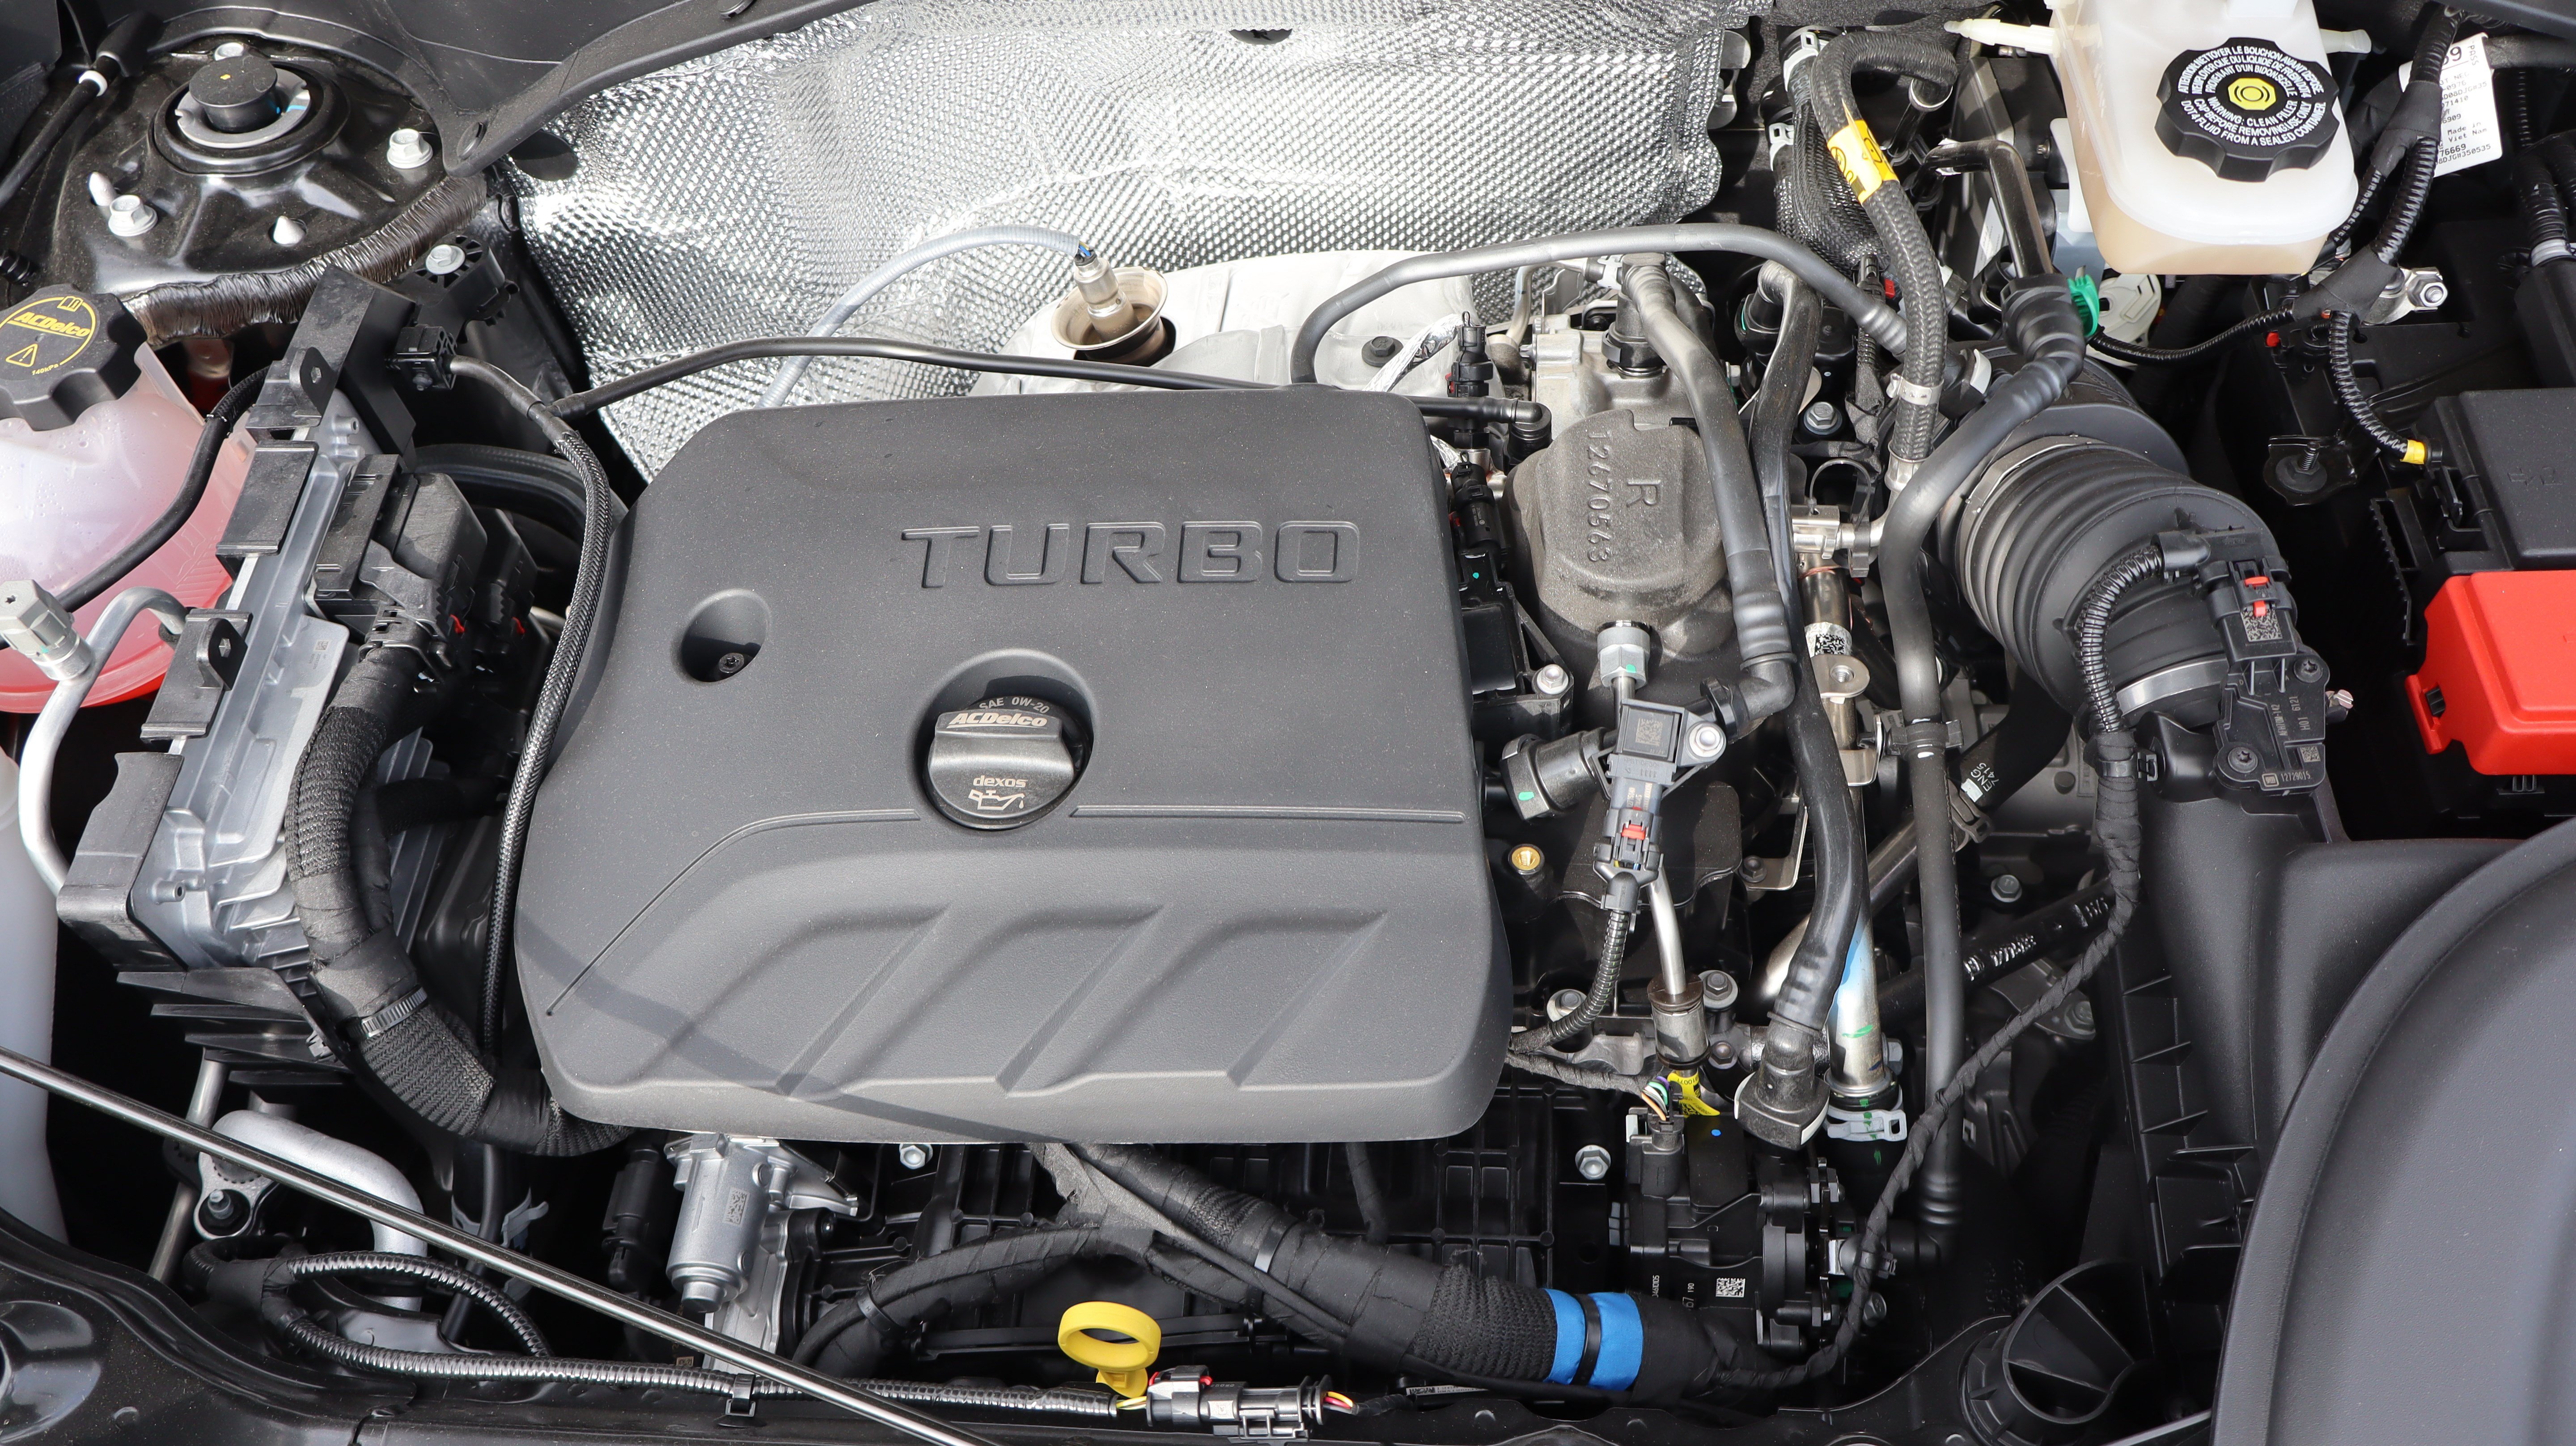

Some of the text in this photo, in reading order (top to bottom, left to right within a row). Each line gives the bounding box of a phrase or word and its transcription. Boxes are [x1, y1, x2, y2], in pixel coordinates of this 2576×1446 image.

[2193, 47, 2232, 68] NETTOYER
[2231, 46, 2243, 55] LE
[2243, 46, 2283, 62] BOUCHON
[2280, 56, 2308, 73] AVANT
[2213, 56, 2231, 68] QUE
[2229, 55, 2241, 64] DU
[2241, 55, 2274, 68] LIQUIDE
[2271, 60, 2285, 72] DE
[2205, 64, 2298, 97] PROVENANT D'UN BIDON SCELLE
[2194, 98, 2210, 112] CAP
[2204, 111, 2238, 133] BEFORE
[2284, 115, 2303, 130] USE
[2296, 101, 2312, 119] ONLY
[2207, 96, 2298, 127] WARNING: CLEAN FILLER
[2195, 116, 2221, 136] FLUID
[2220, 130, 2250, 145] FROM
[2250, 137, 2258, 146] A
[2259, 132, 2296, 146] SEALED
[2447, 126, 2466, 135] Made
[2448, 133, 2467, 143] Viet
[14, 312, 91, 337] ACDelco
[31, 363, 59, 376] 140kPa
[1587, 430, 1610, 562] 12670563
[1626, 479, 1661, 508] R
[901, 521, 1360, 589] TURBO
[979, 696, 1050, 714] SAE 0W-20
[2289, 696, 2301, 712] 6121
[948, 712, 1048, 727] ACDelco
[973, 775, 1029, 788] dexos
[1970, 768, 1993, 792] ENG
[1976, 762, 2000, 786] 7415
[2280, 770, 2311, 782] 12729015
[1687, 1282, 1695, 1293] 190
